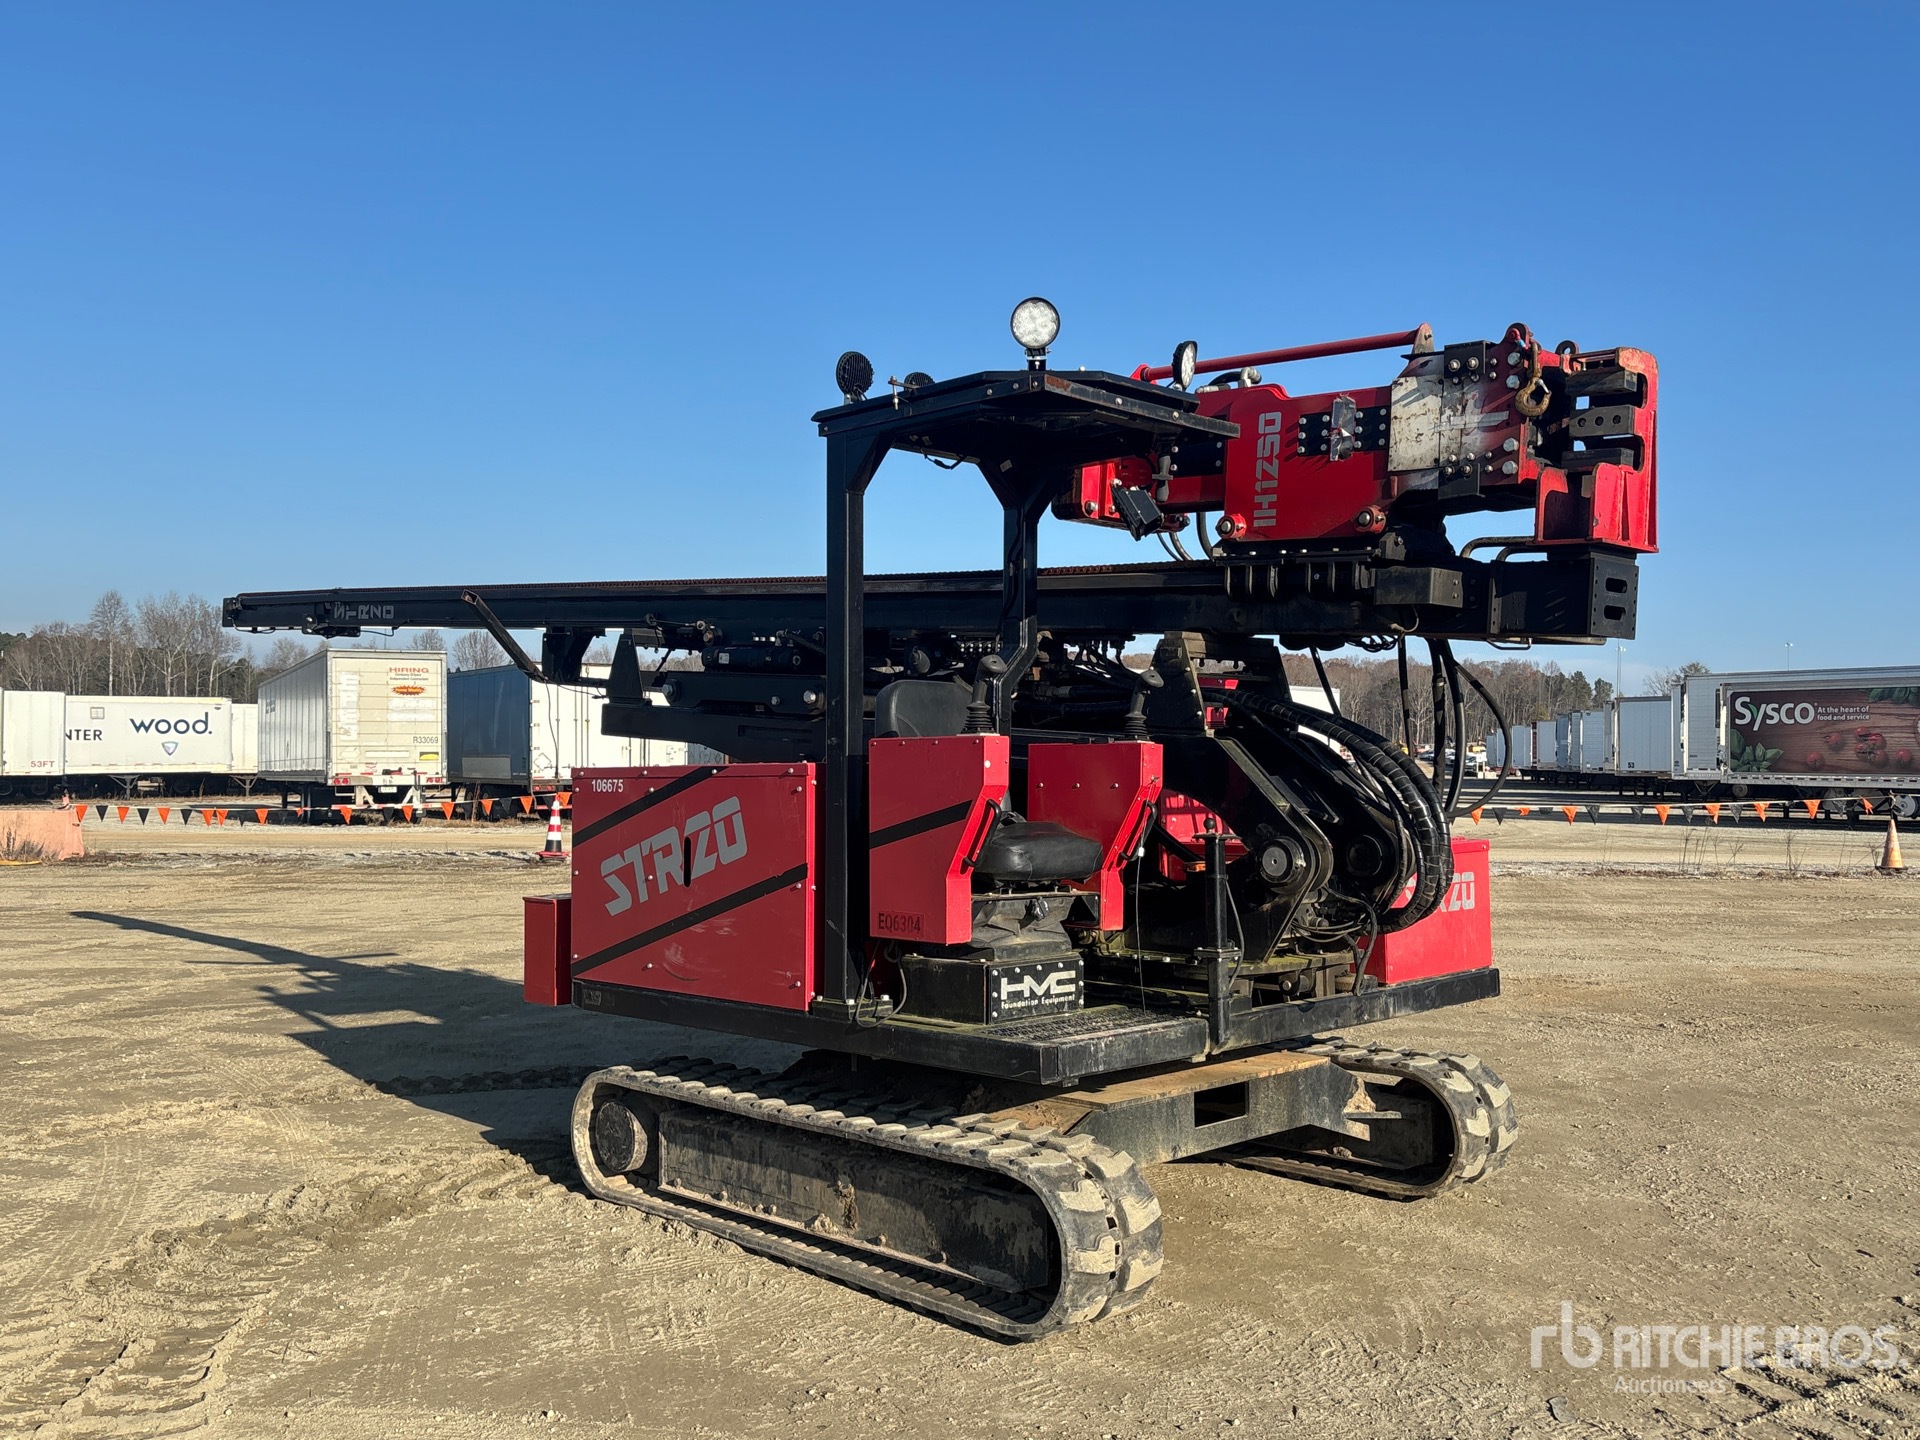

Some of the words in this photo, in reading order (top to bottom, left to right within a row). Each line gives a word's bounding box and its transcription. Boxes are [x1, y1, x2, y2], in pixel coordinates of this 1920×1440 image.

[1253, 411, 1282, 527] IH1250
[129, 711, 213, 735] wood.
[30, 760, 56, 768] 53FT
[591, 779, 624, 793] 106675
[600, 796, 748, 917] STR20
[878, 912, 922, 934] EQ6304
[1000, 970, 1076, 1000] HMC
[1001, 999, 1038, 1009] Foundation
[1041, 993, 1075, 1005] Equipment
